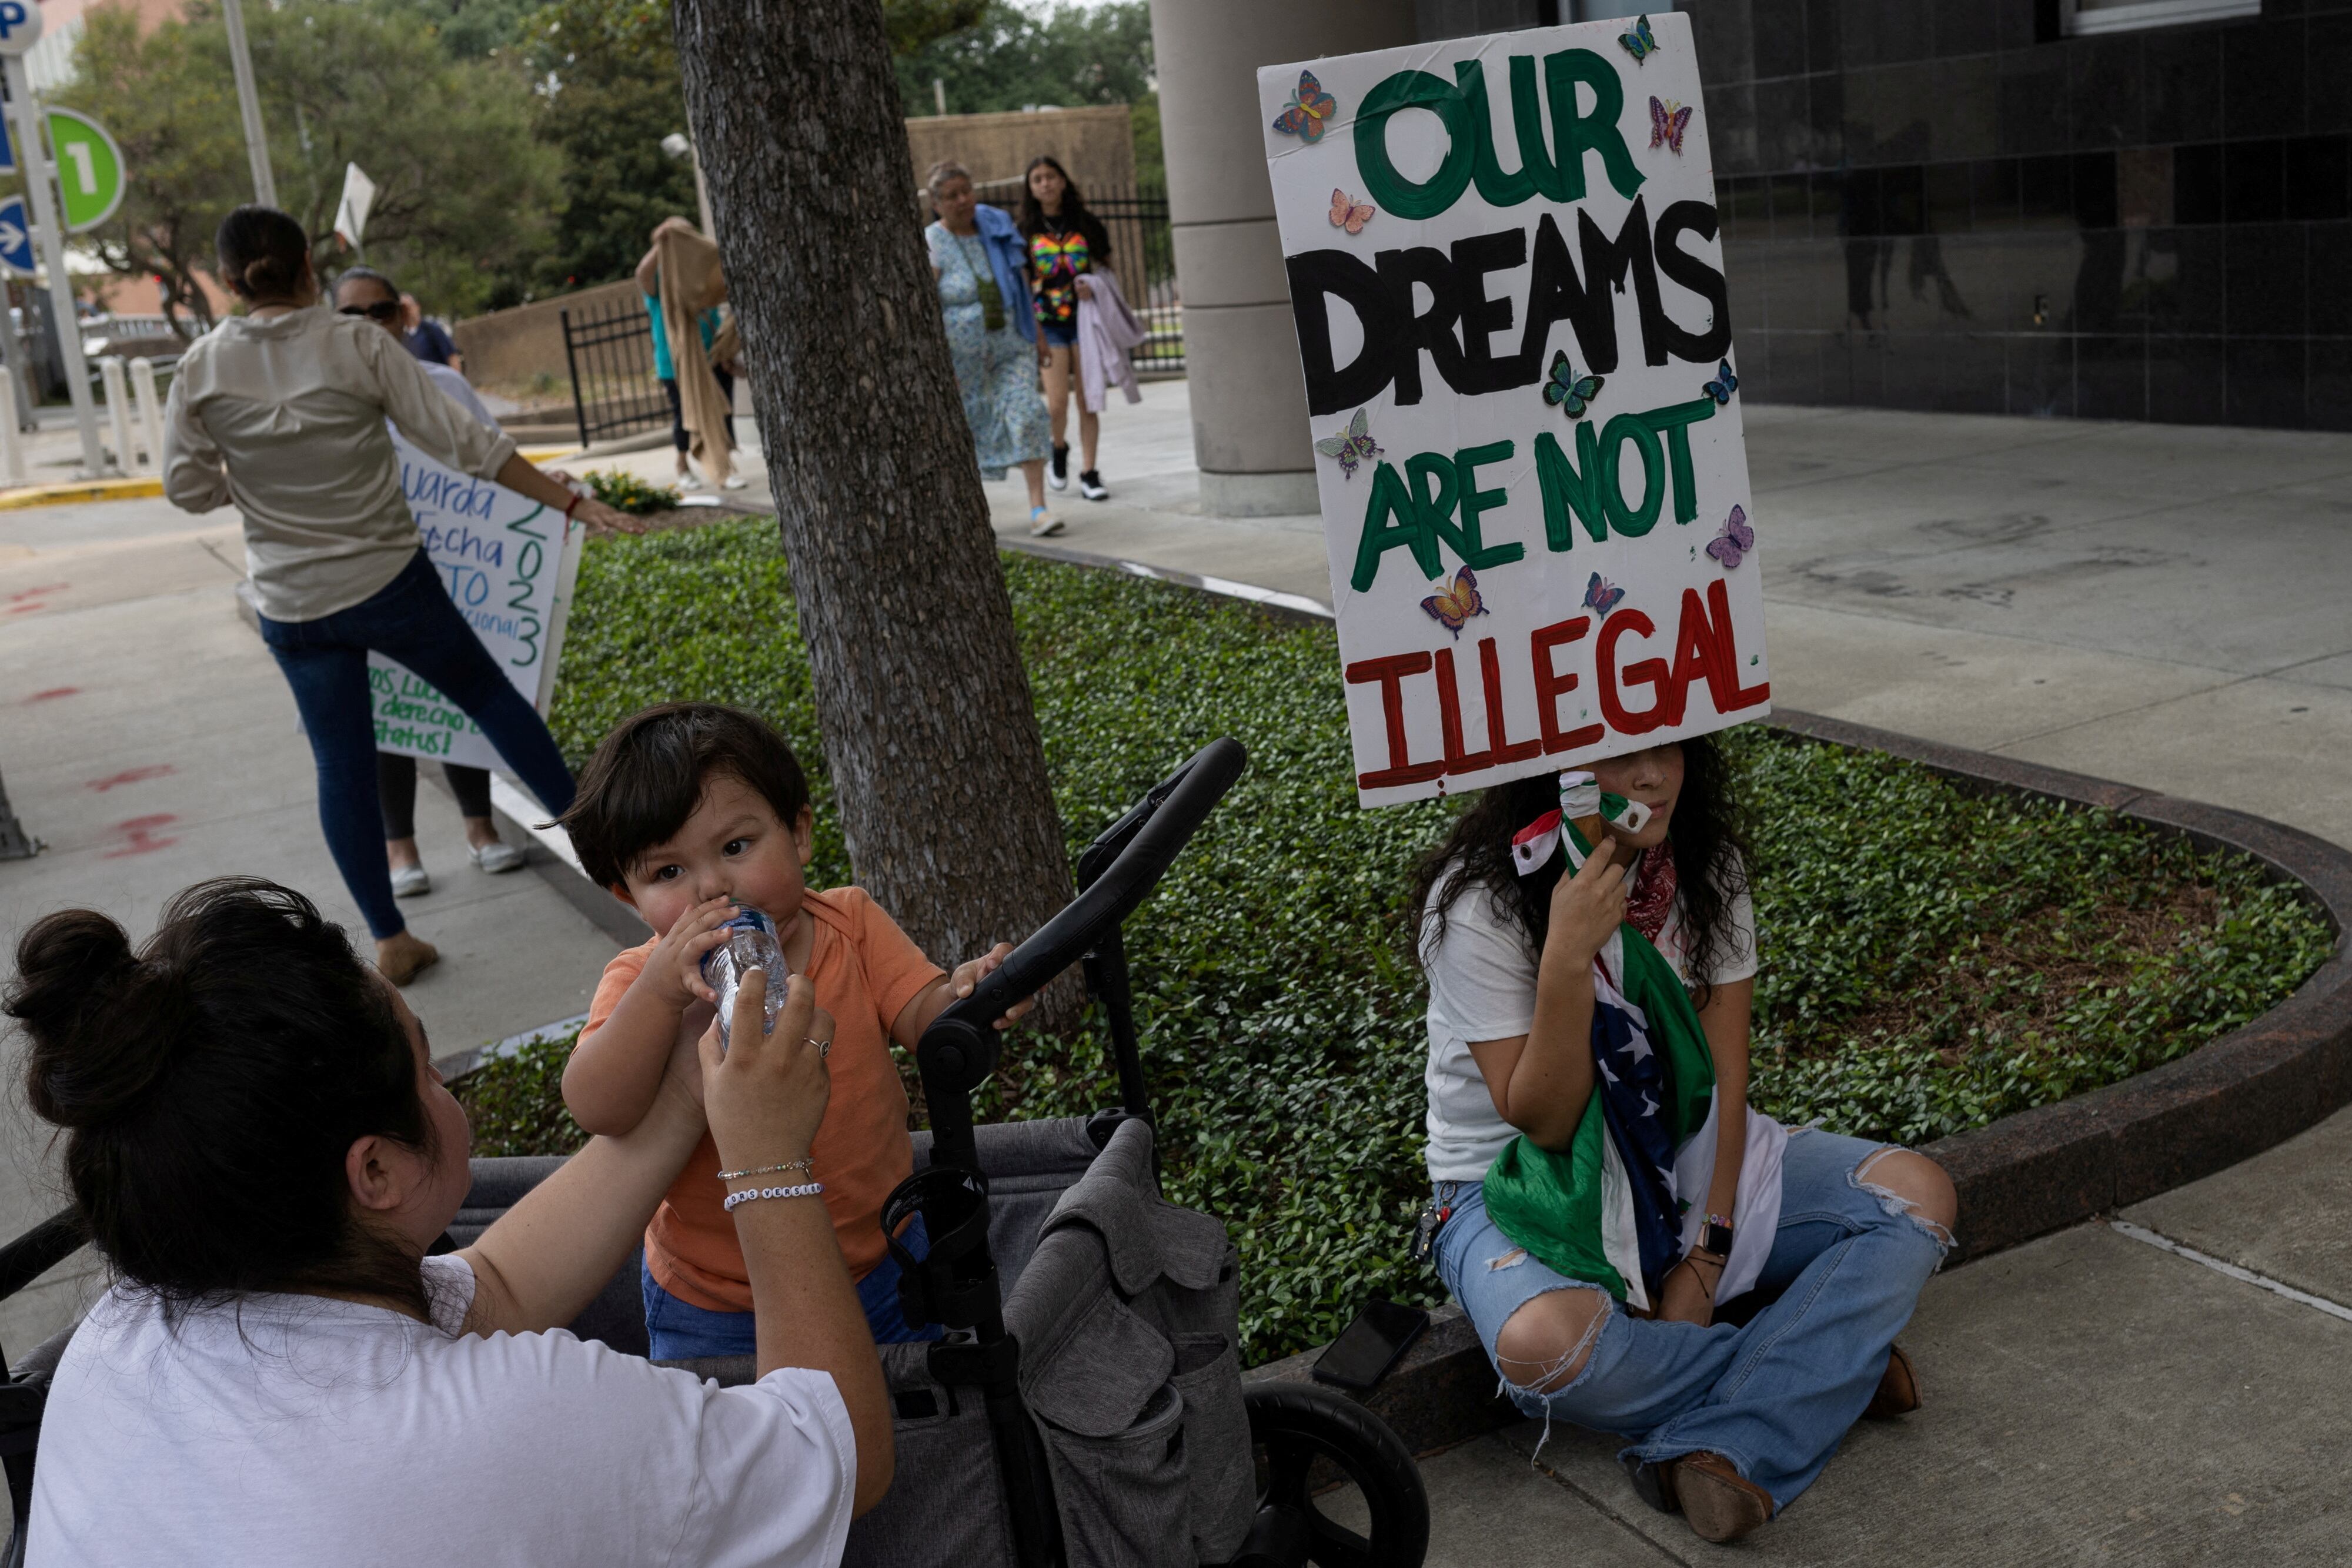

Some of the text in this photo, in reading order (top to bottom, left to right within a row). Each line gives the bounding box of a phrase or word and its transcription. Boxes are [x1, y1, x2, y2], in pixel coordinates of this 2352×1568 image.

[0, 2, 26, 39] P
[65, 142, 98, 195] 1
[1353, 47, 1648, 220] OUR
[1285, 193, 1733, 417] DREAMS
[403, 463, 496, 519] uarda
[1350, 397, 1716, 593] ARE NOT
[1345, 578, 1771, 790] ILLEGAL
[765, 1185, 821, 1197] VERSION
